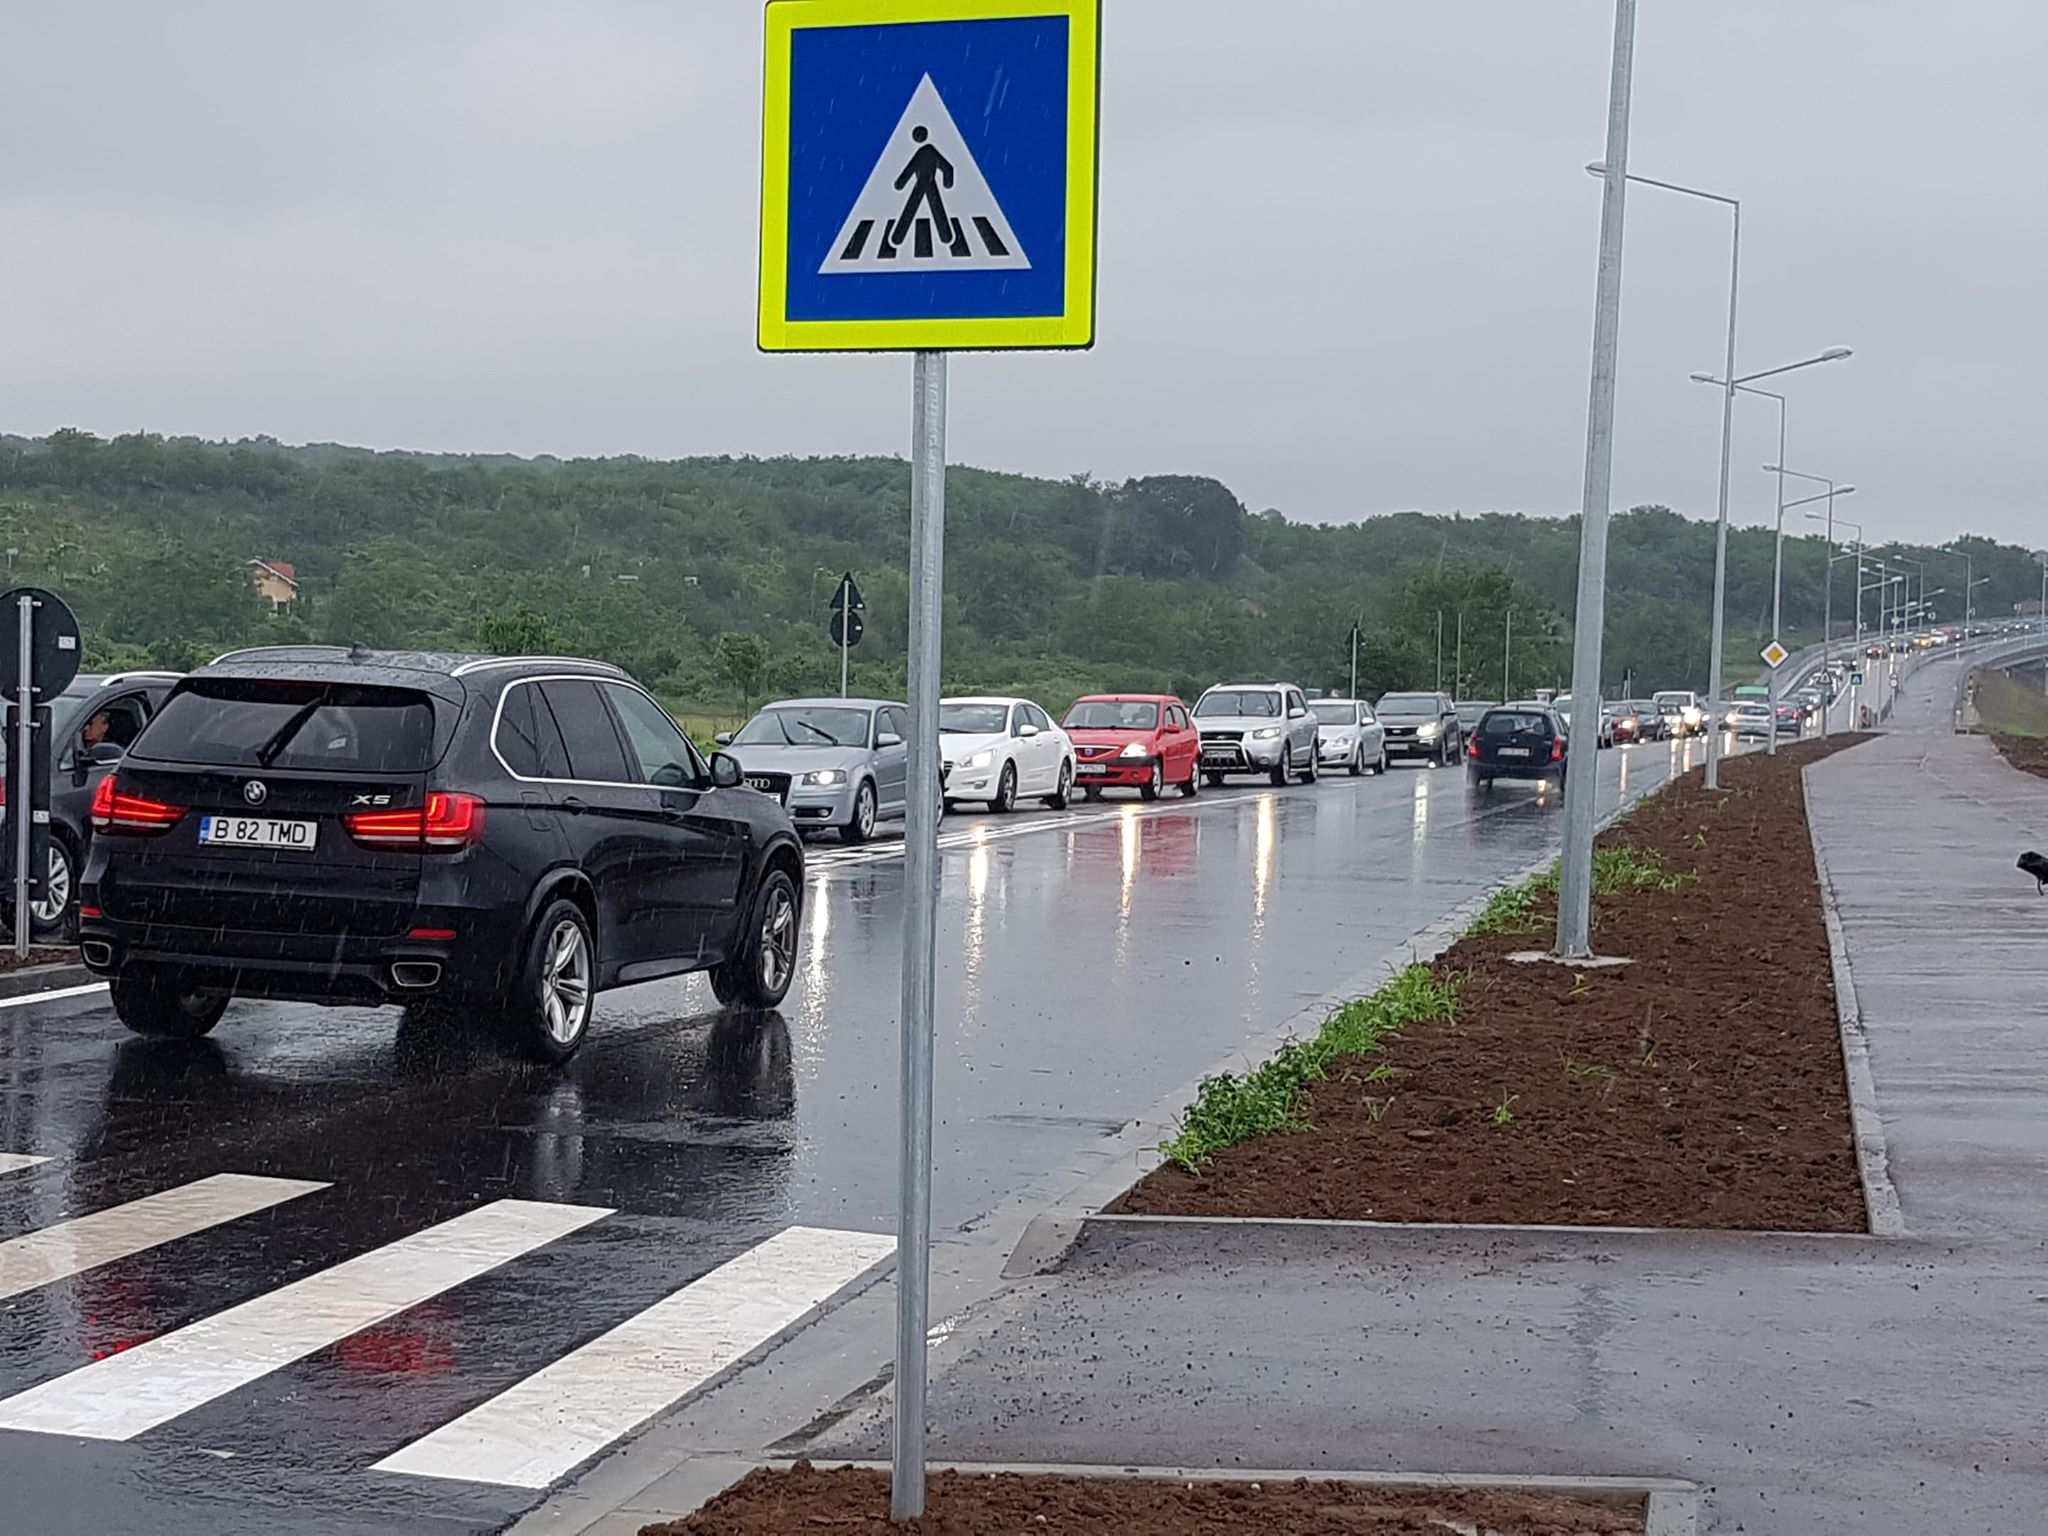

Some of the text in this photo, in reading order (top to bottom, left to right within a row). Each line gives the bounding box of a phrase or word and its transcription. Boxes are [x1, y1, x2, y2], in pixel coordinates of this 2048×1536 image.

[352, 795, 391, 805] X5
[215, 819, 306, 844] B 82 TMD
